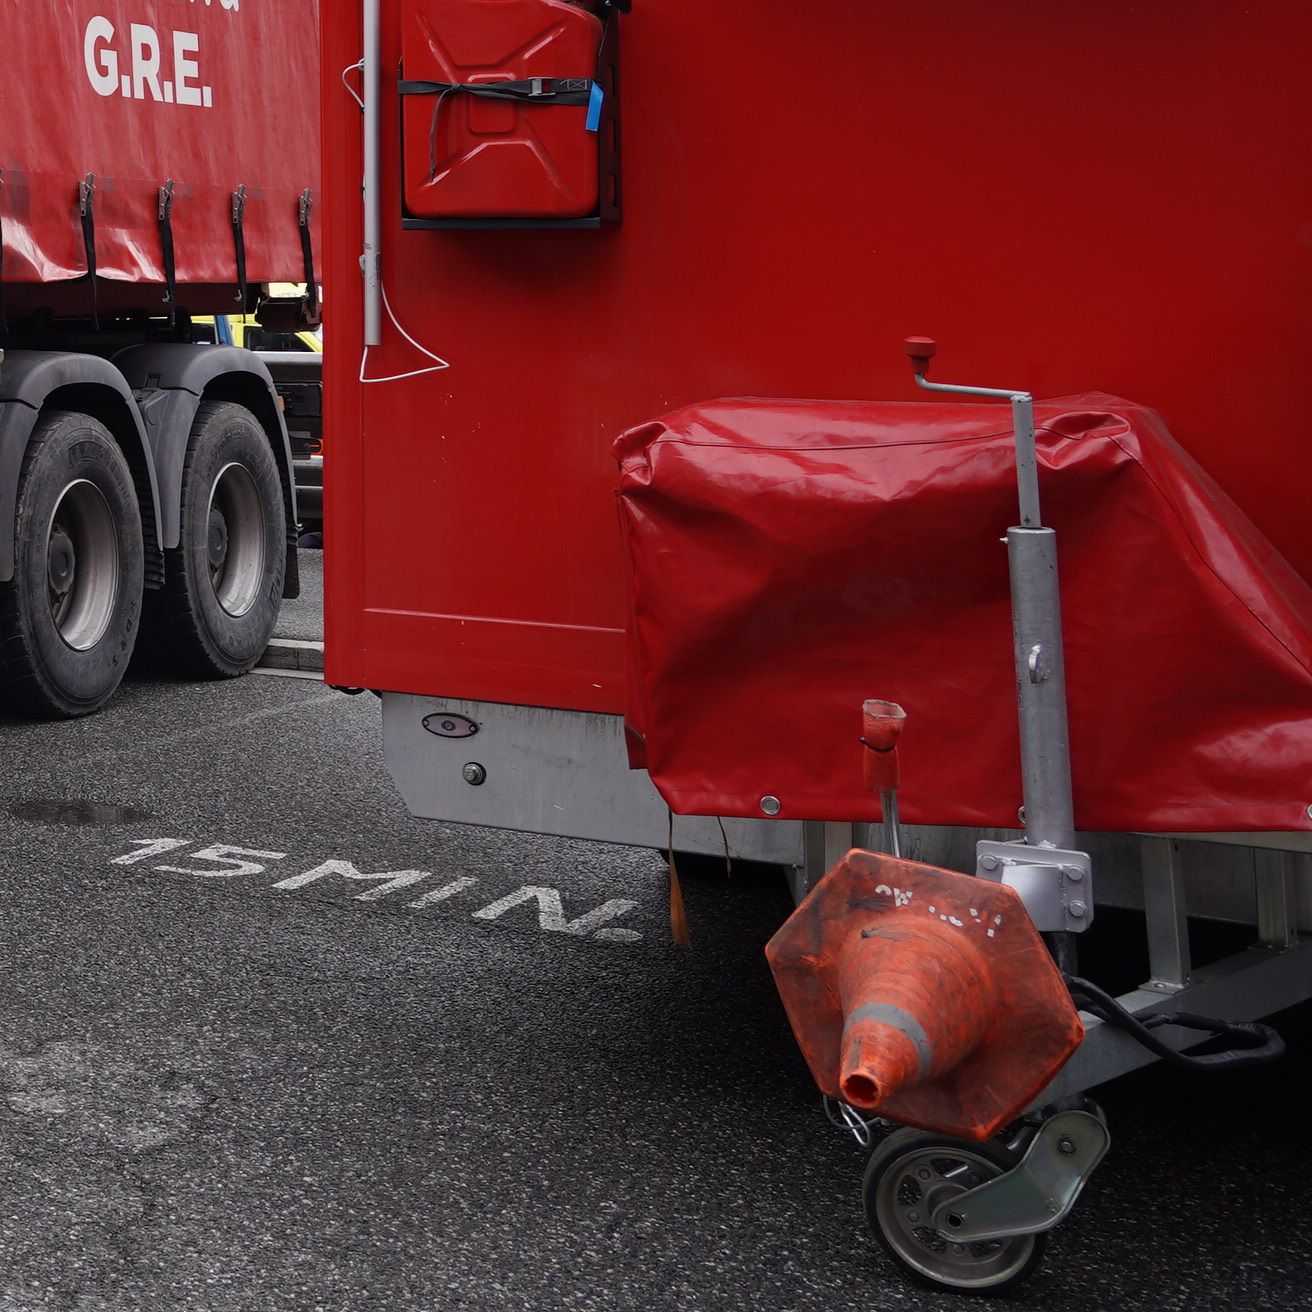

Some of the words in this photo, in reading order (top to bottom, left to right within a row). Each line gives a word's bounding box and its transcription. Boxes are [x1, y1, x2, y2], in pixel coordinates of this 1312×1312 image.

[83, 15, 213, 108] G.R.E.
[111, 837, 287, 878] 15
[271, 859, 643, 942] MIN.
